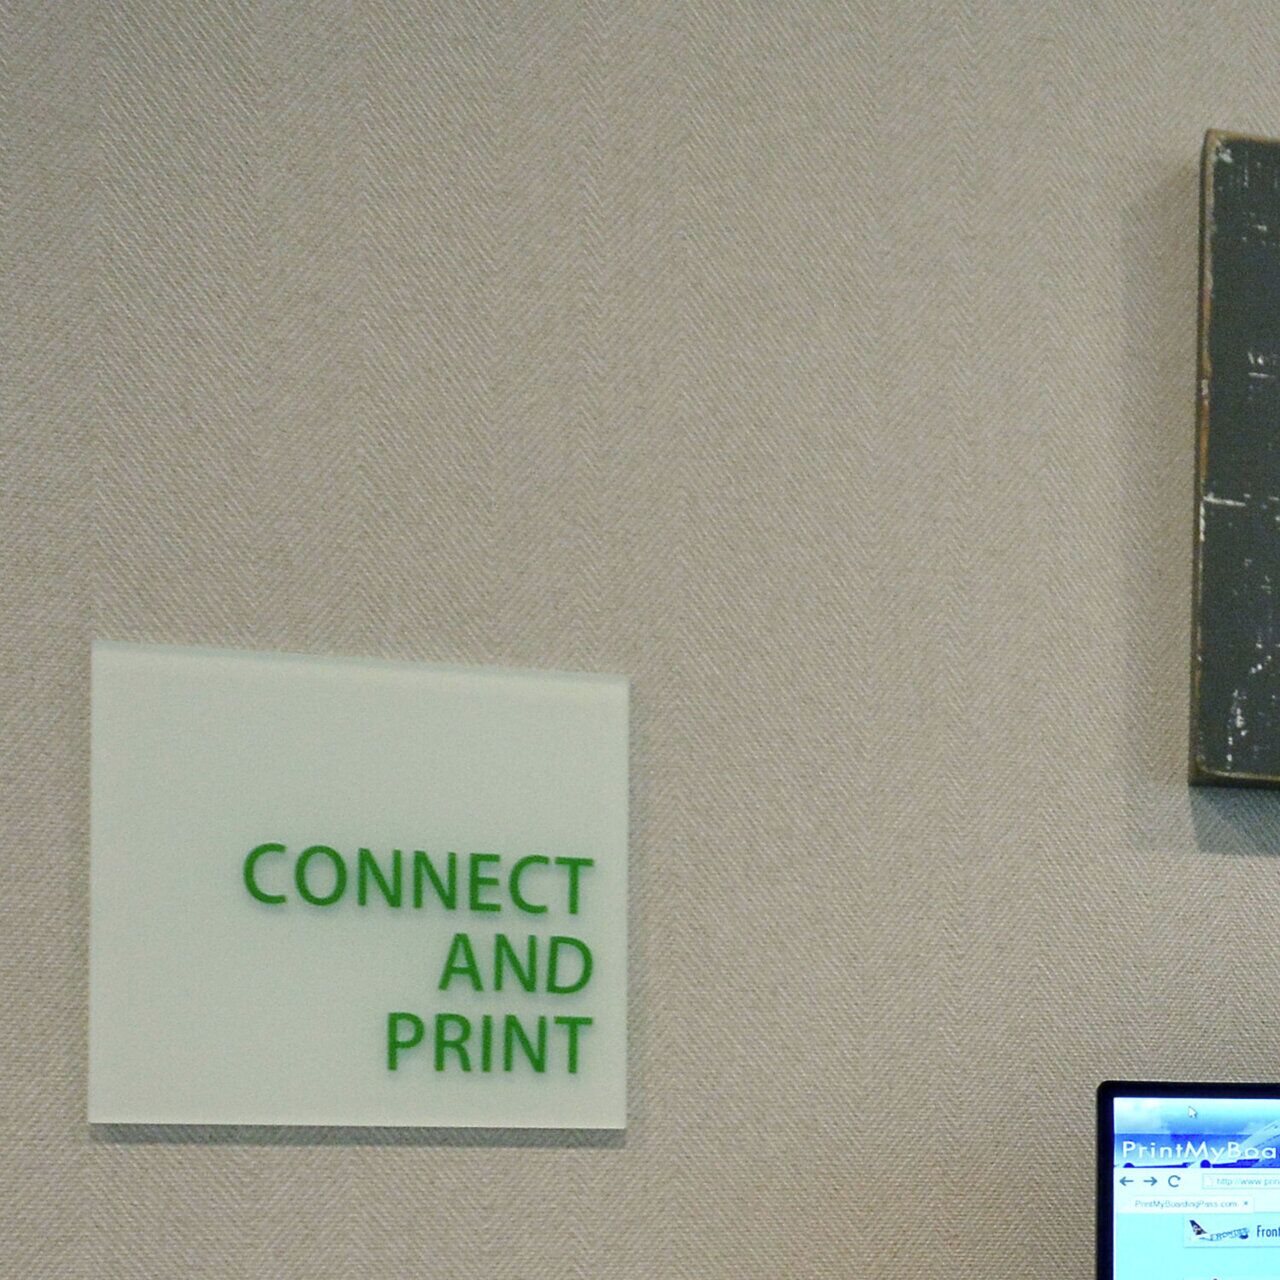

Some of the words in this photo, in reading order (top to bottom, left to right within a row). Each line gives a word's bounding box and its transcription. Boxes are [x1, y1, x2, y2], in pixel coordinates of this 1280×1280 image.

[243, 843, 594, 915] CONNECT
[438, 933, 594, 995] AND
[387, 1011, 593, 1075] PRINT
